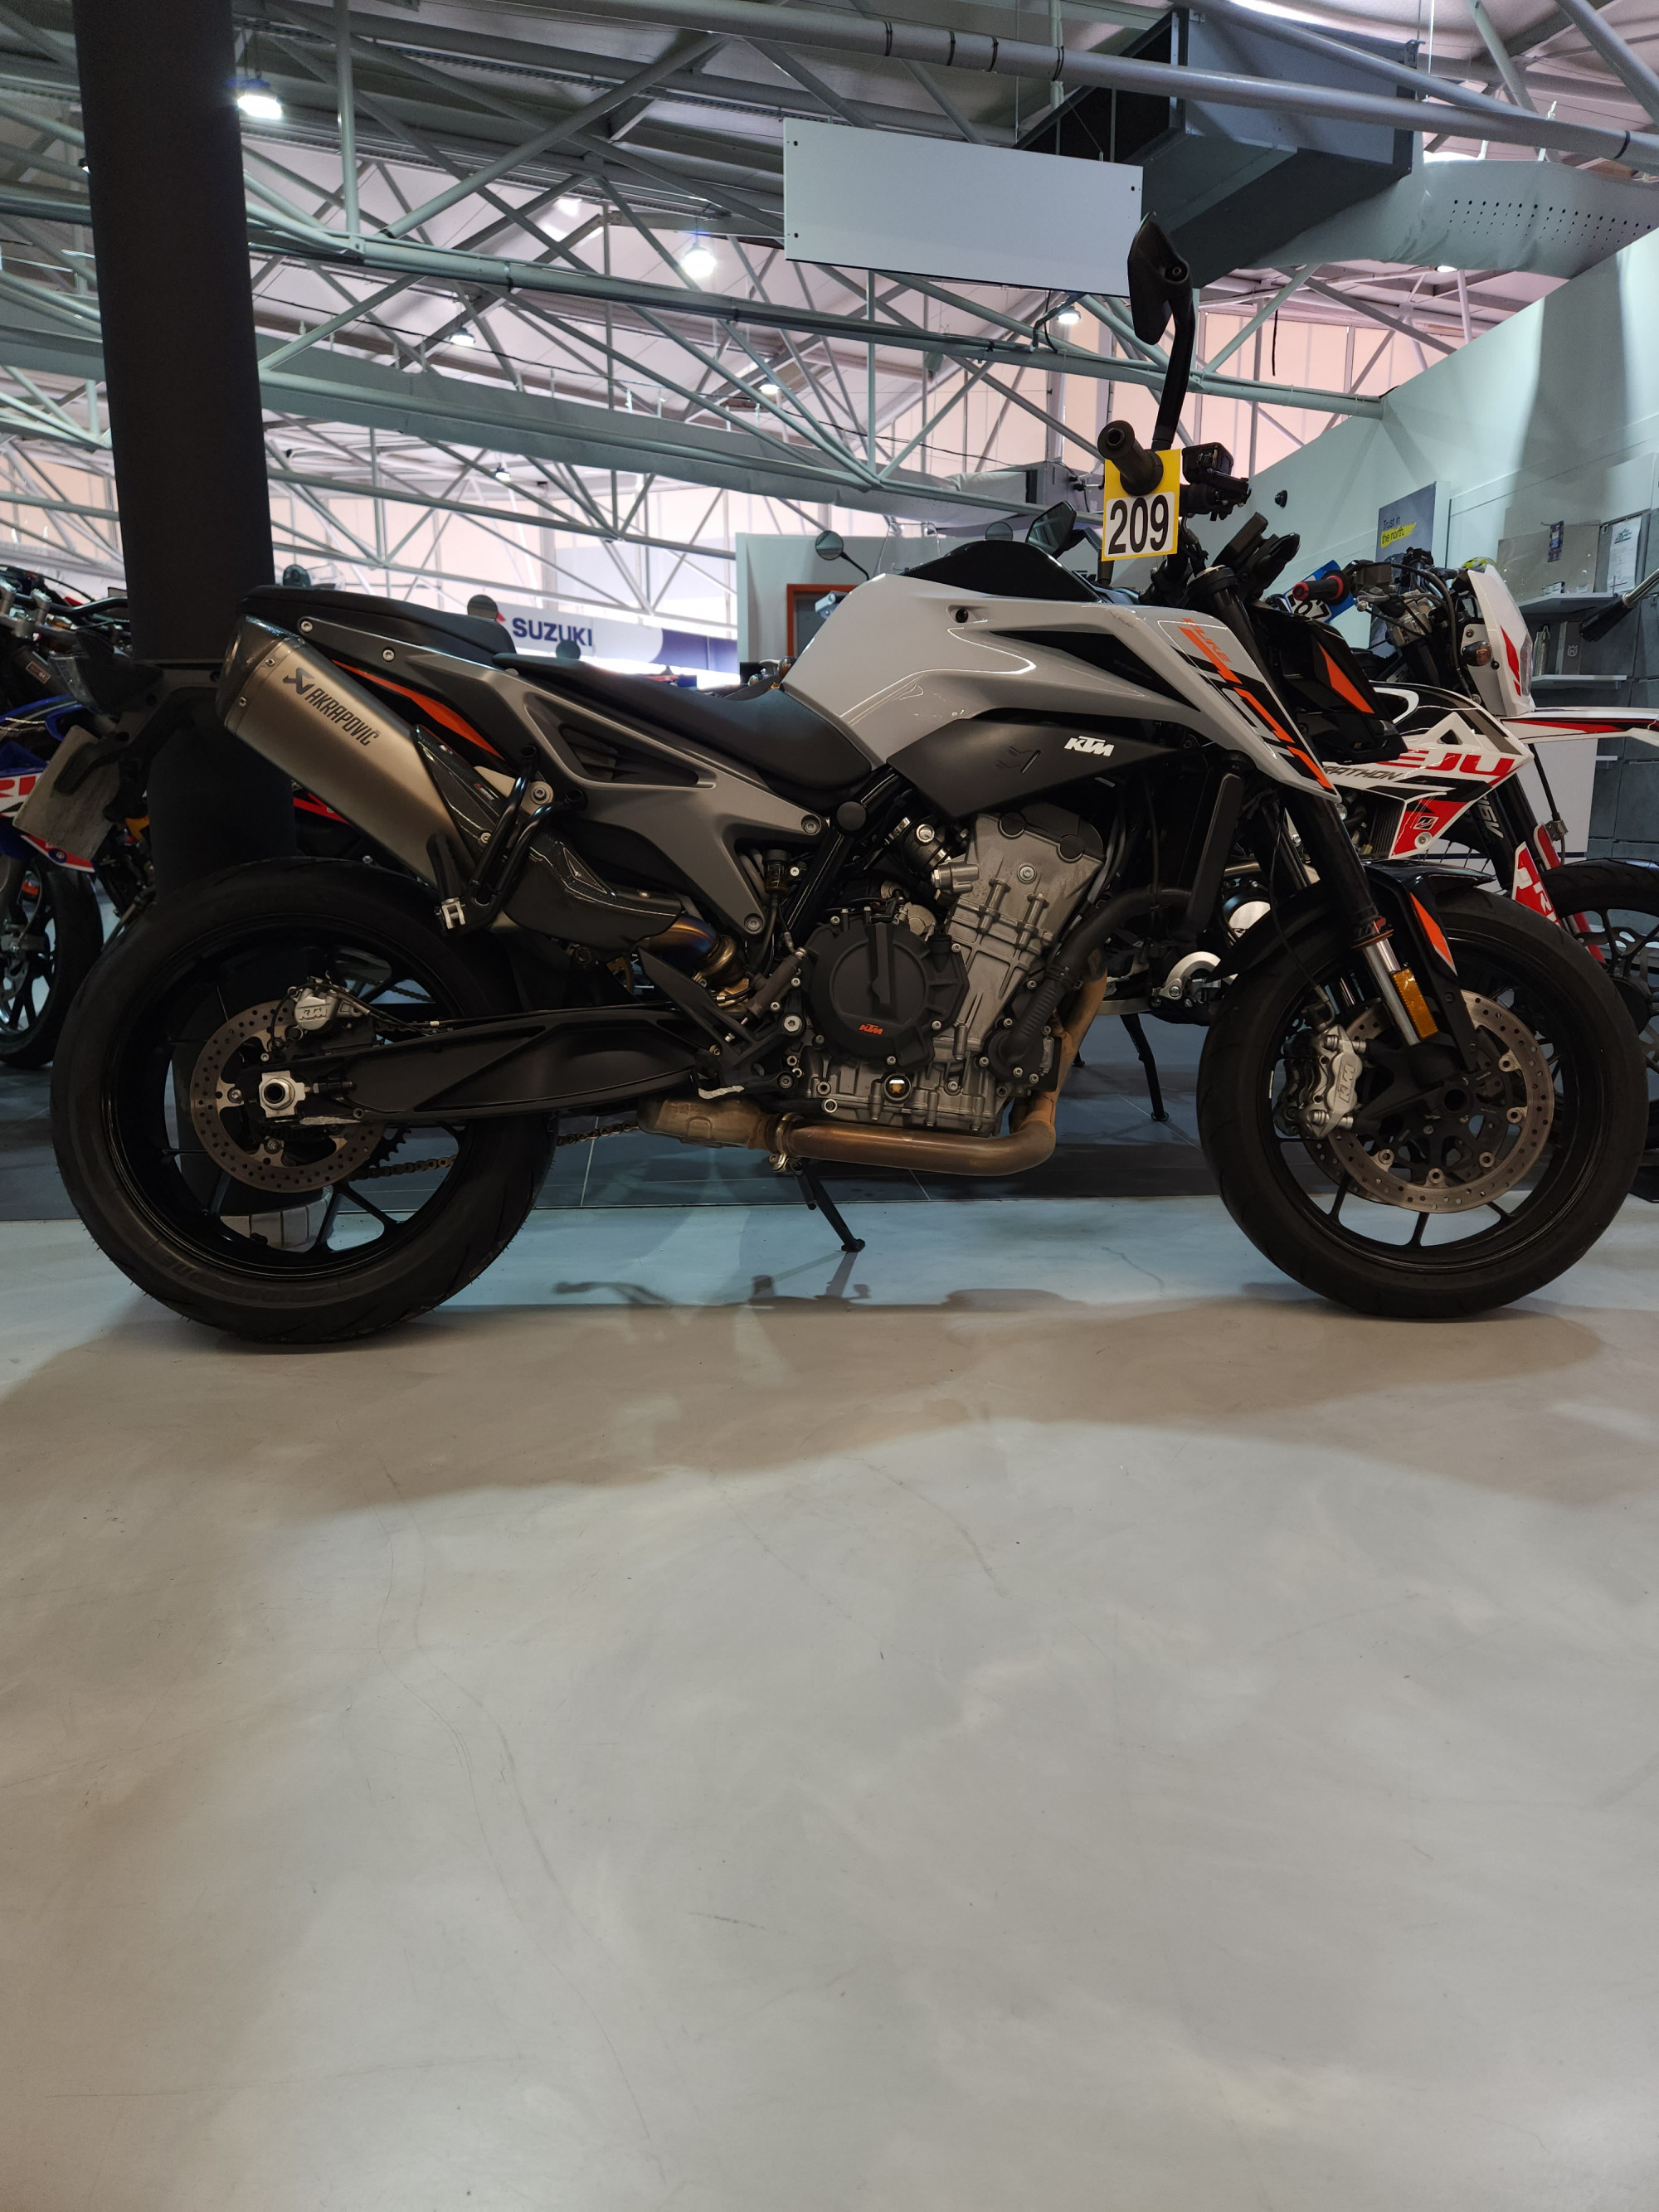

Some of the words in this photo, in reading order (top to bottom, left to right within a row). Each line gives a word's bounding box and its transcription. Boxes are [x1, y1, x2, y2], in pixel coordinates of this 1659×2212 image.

[1108, 495, 1169, 555] 209
[1383, 517, 1395, 530] Trust
[1381, 532, 1390, 545] the
[512, 617, 593, 647] SUZUKI
[1182, 618, 1232, 663] DUKE
[1063, 736, 1115, 756] KTM
[298, 1006, 328, 1021] KTM
[859, 1023, 883, 1035] KTM
[1338, 1063, 1355, 1103] KTM
